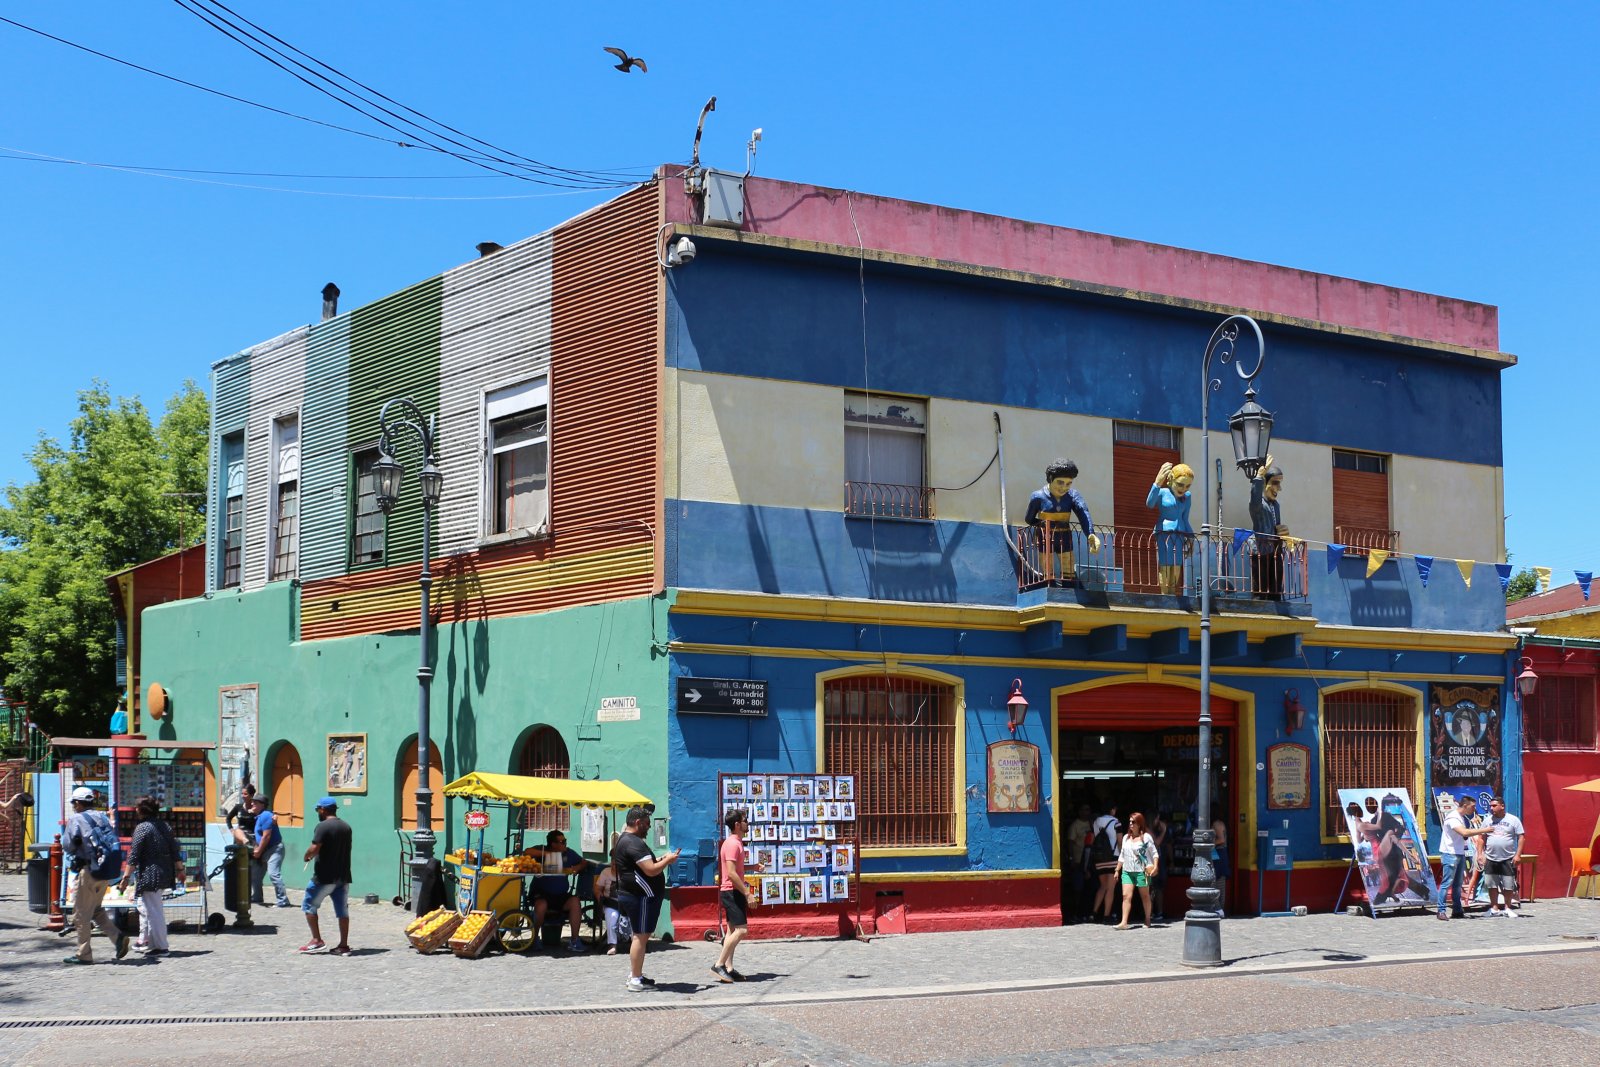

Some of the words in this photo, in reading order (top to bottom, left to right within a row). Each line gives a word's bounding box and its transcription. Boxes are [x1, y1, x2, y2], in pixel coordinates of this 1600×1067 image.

[729, 690, 764, 698] Lamadrid
[602, 697, 635, 708] CAMINITO
[1163, 733, 1223, 747] DEPORES
[1449, 747, 1475, 755] CENTRO
[1476, 747, 1485, 755] DE
[1449, 755, 1485, 766] EXPOSICIONES
